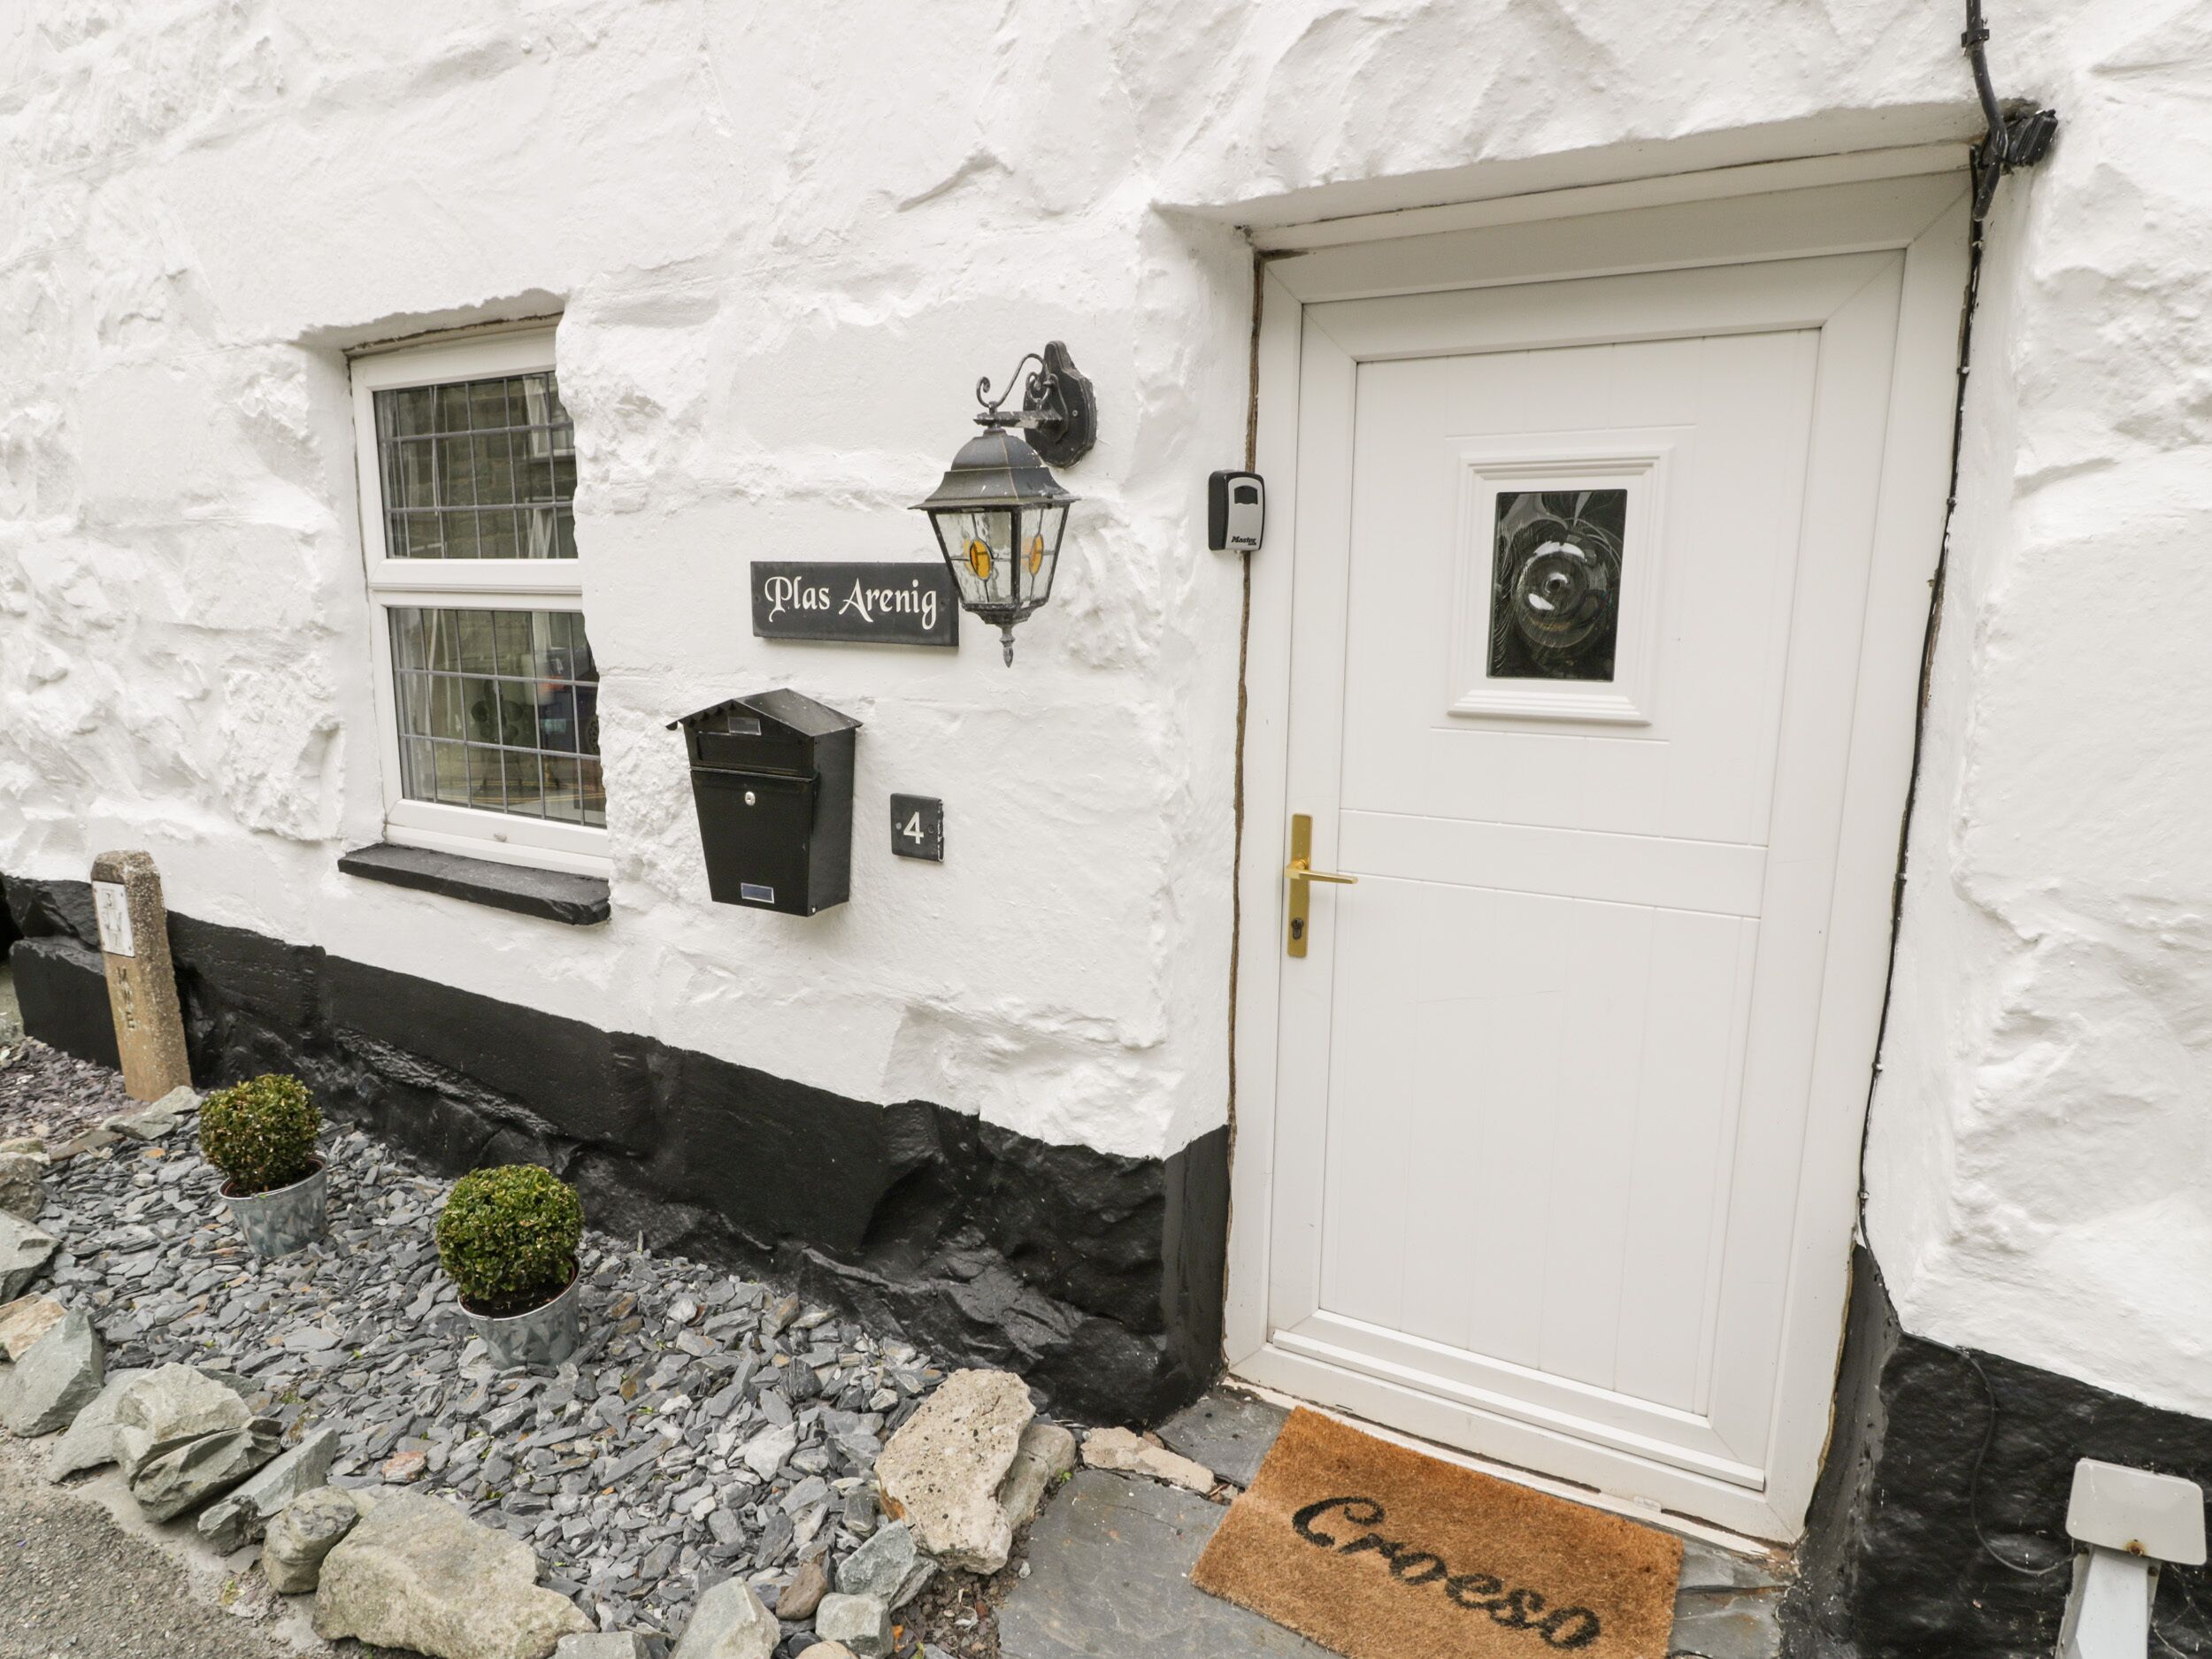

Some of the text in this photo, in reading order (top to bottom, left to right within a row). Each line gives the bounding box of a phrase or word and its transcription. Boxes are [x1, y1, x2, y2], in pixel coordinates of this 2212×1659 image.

[764, 576, 937, 630] Plas Arenig
[903, 811, 924, 844] 4
[1292, 1496, 1601, 1650] Croeso
